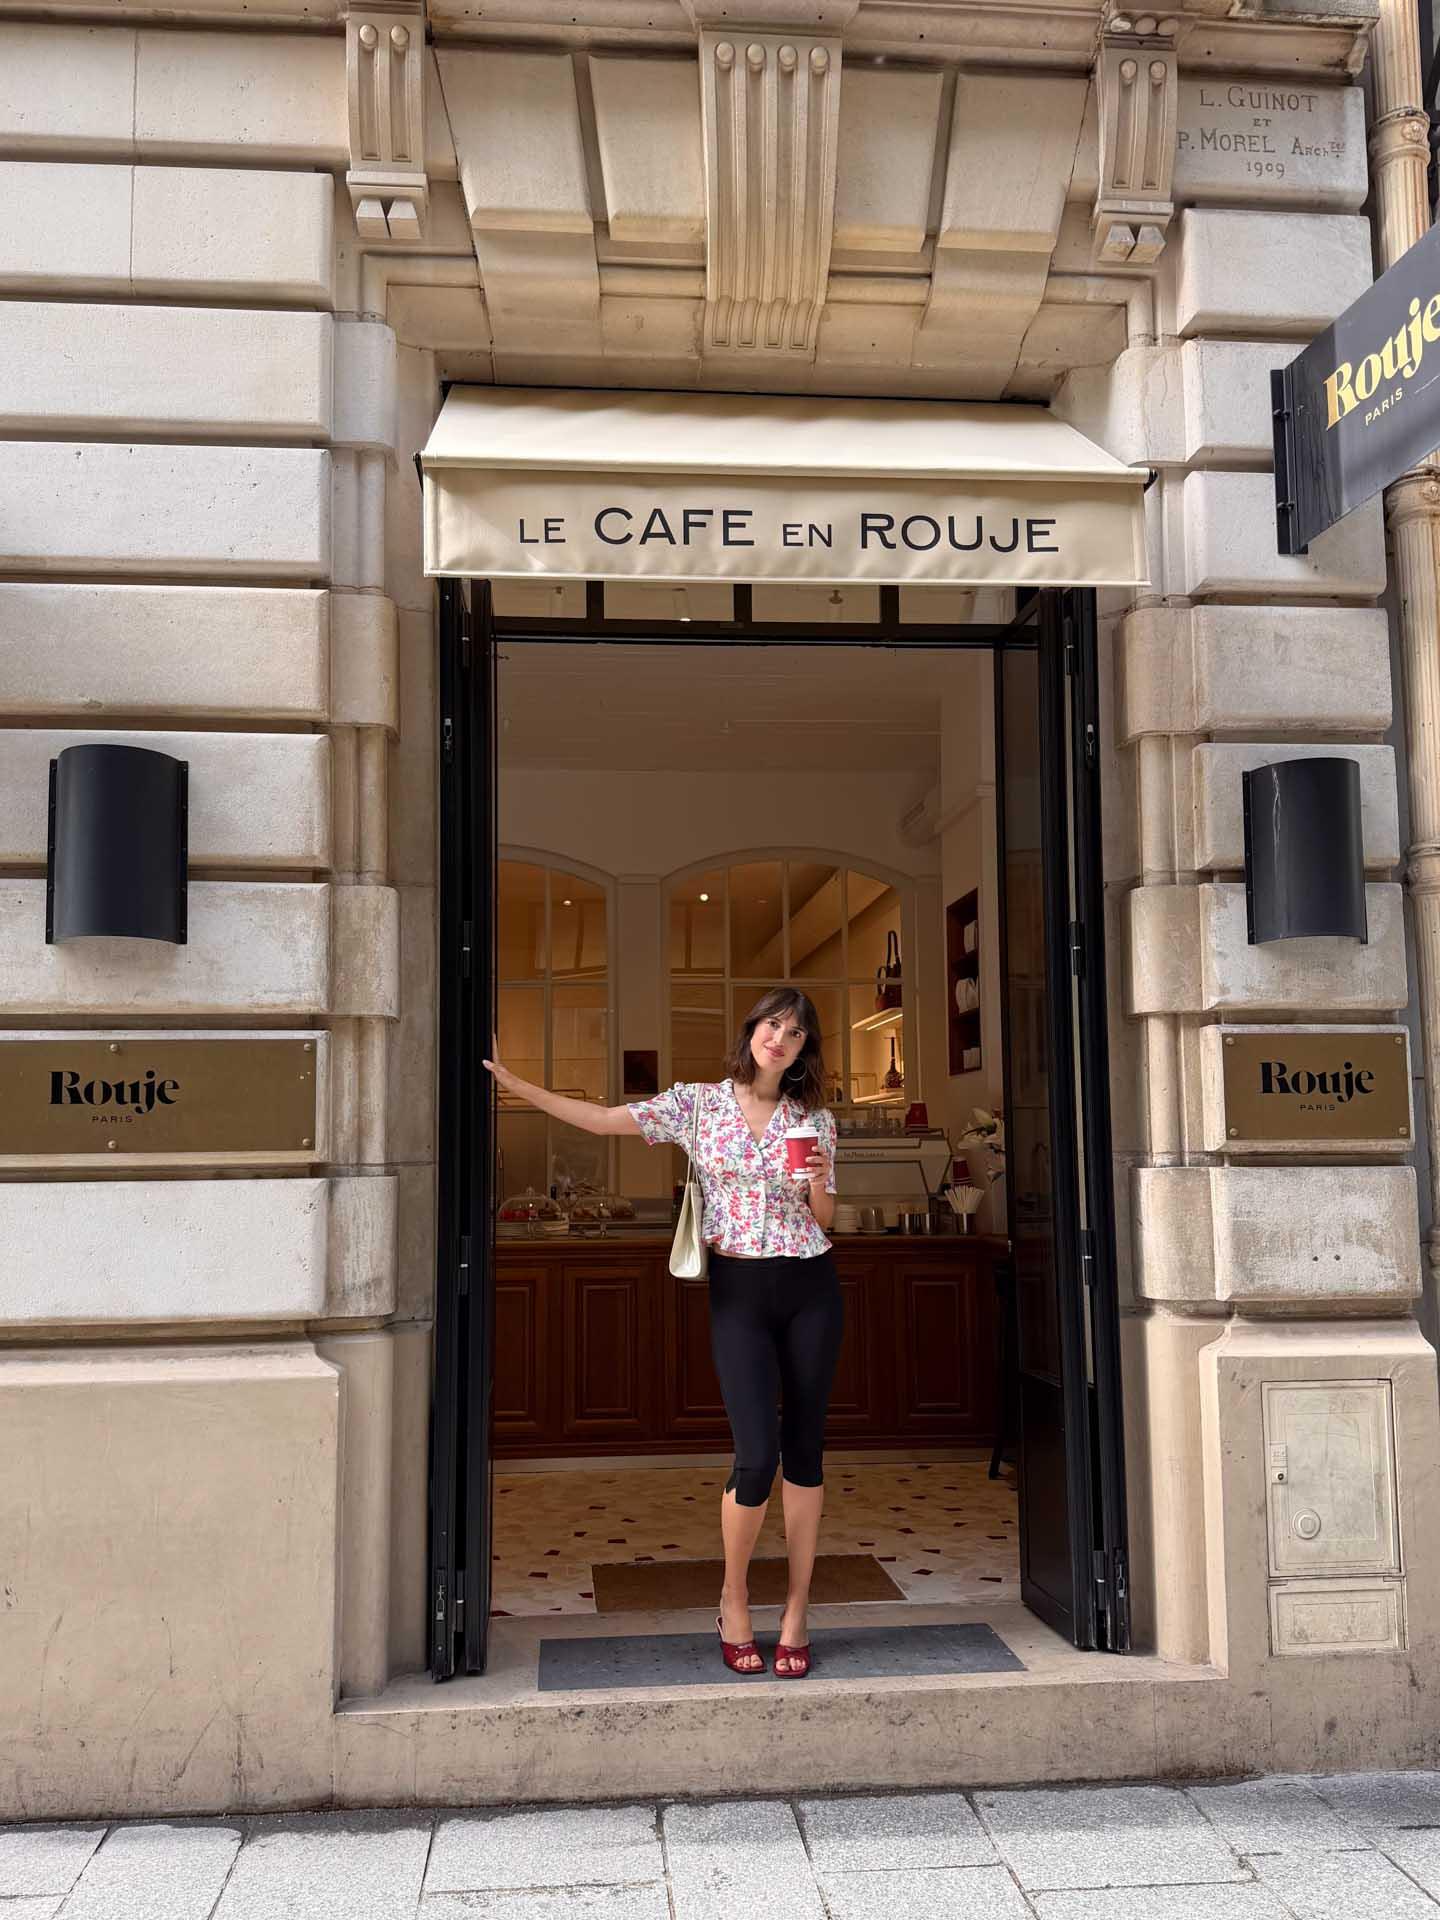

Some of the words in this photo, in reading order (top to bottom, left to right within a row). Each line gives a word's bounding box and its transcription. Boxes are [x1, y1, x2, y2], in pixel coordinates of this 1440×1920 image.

[1199, 88, 1222, 107] L.
[1177, 131, 1195, 150] P.
[1200, 128, 1276, 153] MOREL
[1247, 161, 1285, 179] 1909
[1322, 291, 1440, 431] Rouje
[1365, 387, 1404, 426] PARIS
[519, 518, 566, 544] LE
[594, 507, 755, 546] CAFE
[782, 523, 833, 547] EN
[860, 513, 1059, 552] ROUJE
[48, 1070, 181, 1114] Rouje
[1259, 1061, 1376, 1103] Rouje
[91, 1115, 133, 1123] PARIS
